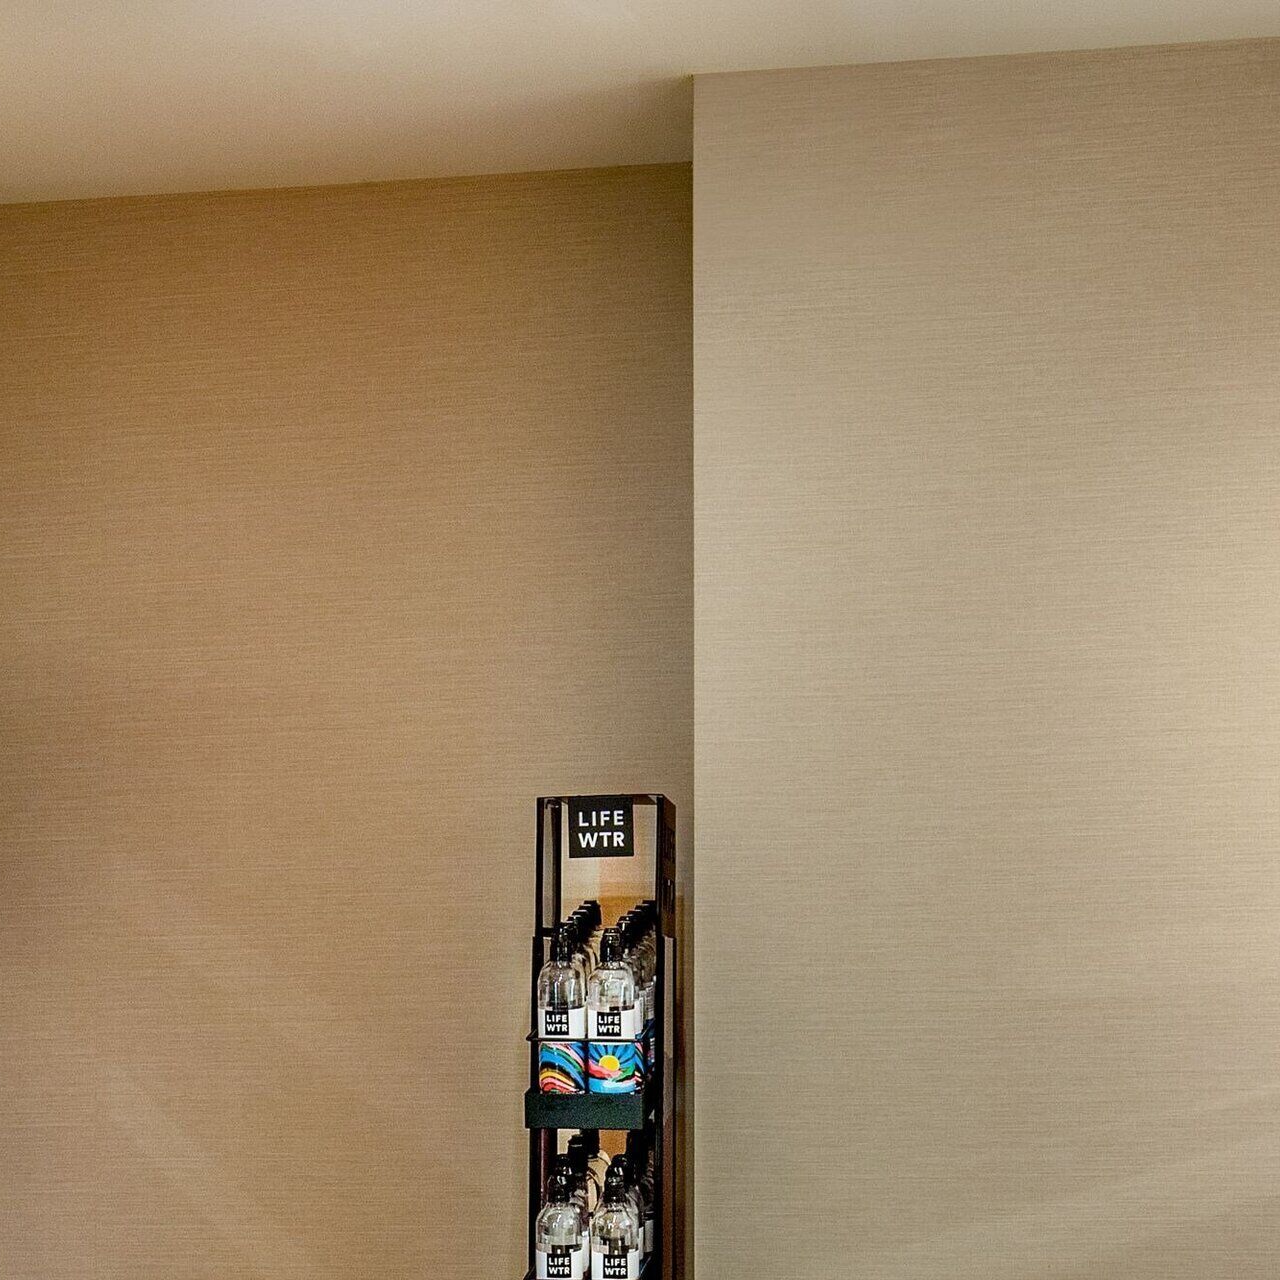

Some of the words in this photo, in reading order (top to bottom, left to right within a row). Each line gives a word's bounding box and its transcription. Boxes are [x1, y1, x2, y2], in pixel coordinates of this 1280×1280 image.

[578, 810, 625, 827] LIFE
[578, 831, 625, 848] WTR
[546, 1014, 568, 1023] LIFE
[598, 1015, 620, 1024] LIFE
[546, 1023, 568, 1033] WTR
[597, 1024, 621, 1034] WTR
[548, 1256, 570, 1266] LIFE
[604, 1257, 626, 1267] LIFE
[548, 1266, 571, 1275] WTR
[604, 1267, 627, 1276] WTR
